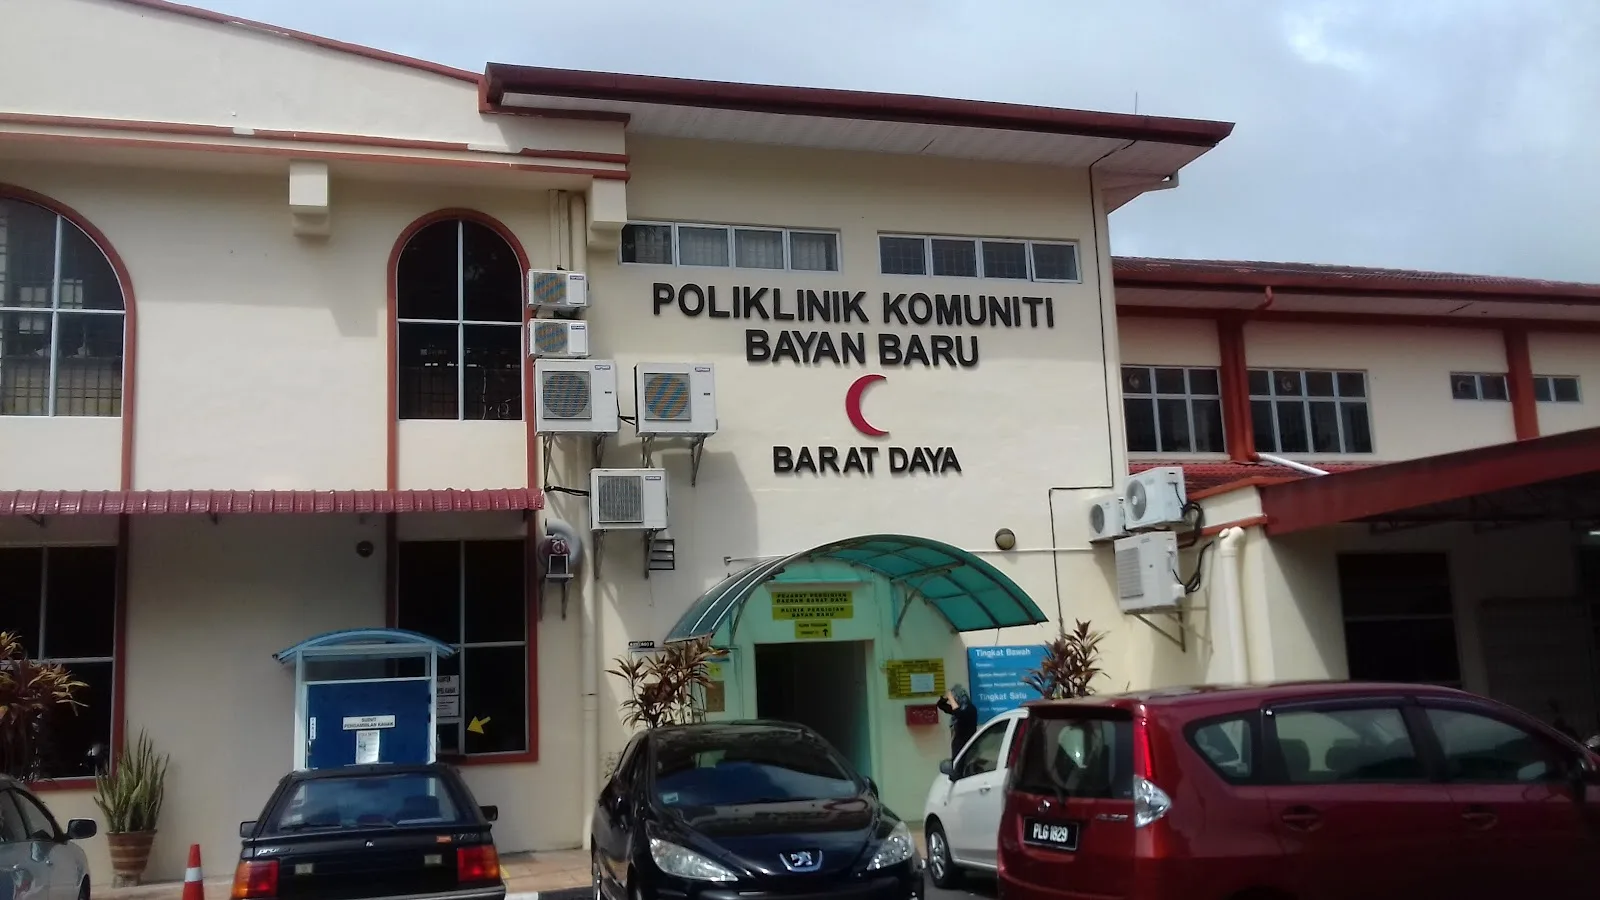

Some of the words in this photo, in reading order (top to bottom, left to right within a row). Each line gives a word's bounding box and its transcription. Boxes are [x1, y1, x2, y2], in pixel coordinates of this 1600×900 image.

[653, 282, 869, 323] POLIKLINIK
[882, 292, 1054, 328] KOMUNITI
[745, 329, 866, 364] BAYAN
[878, 333, 978, 367] BARU
[773, 446, 878, 473] BARAT
[889, 446, 962, 473] DAYA
[976, 648, 1004, 659] Tingkat
[1006, 647, 1031, 656] Bawah
[978, 692, 1007, 702] Tingkat
[1009, 691, 1027, 700] Satu
[1033, 822, 1050, 840] PLG
[1050, 824, 1069, 843] 1829
